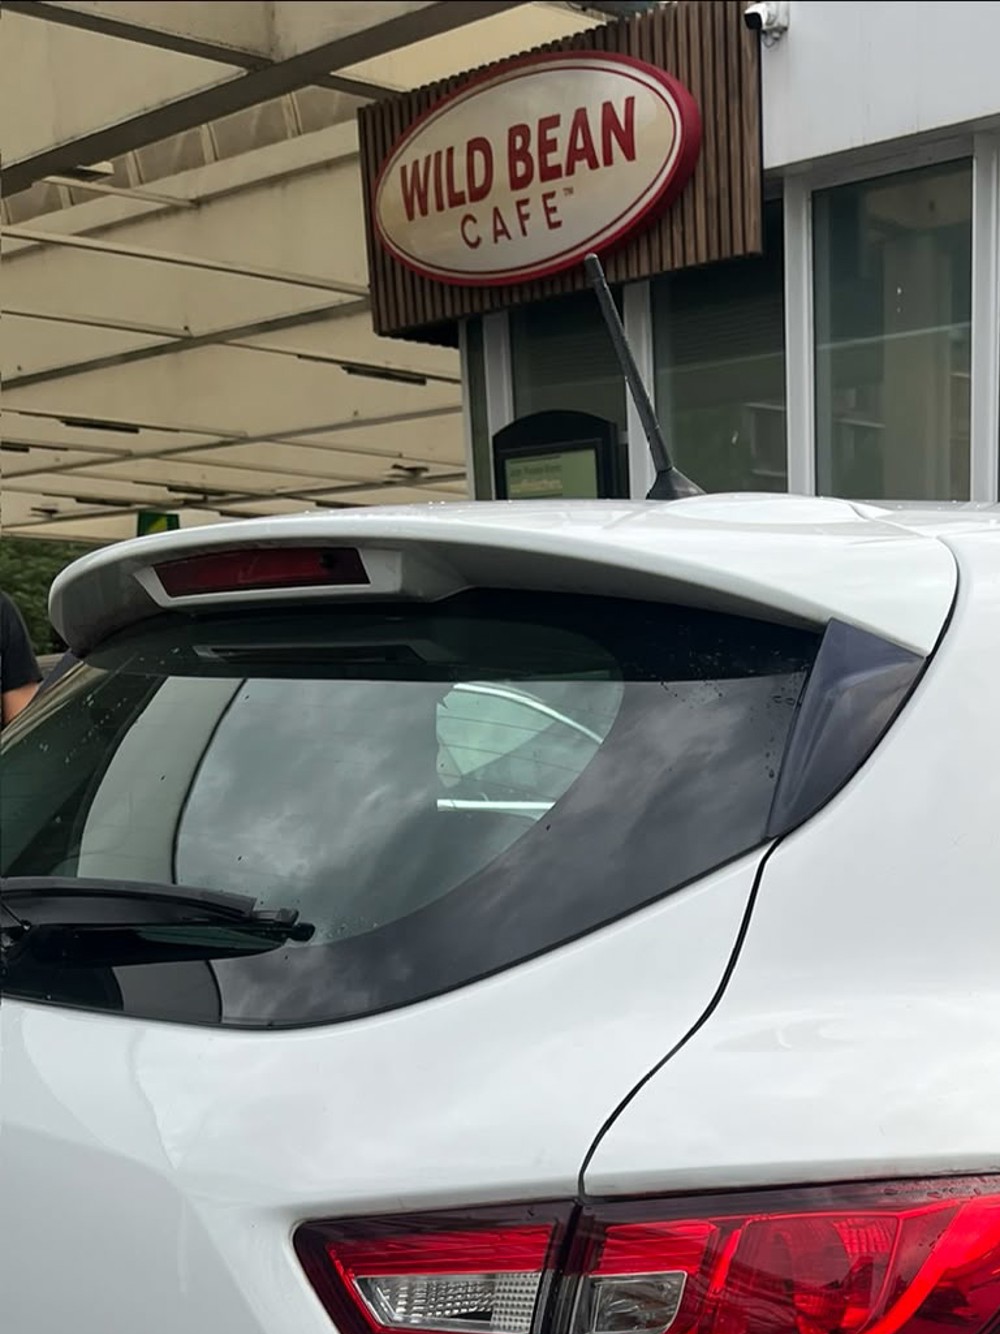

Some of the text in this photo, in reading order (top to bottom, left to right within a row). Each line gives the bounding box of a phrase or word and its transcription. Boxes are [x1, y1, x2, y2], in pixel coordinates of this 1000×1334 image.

[400, 96, 637, 222] WILD BEAN
[460, 191, 563, 249] CAFE
